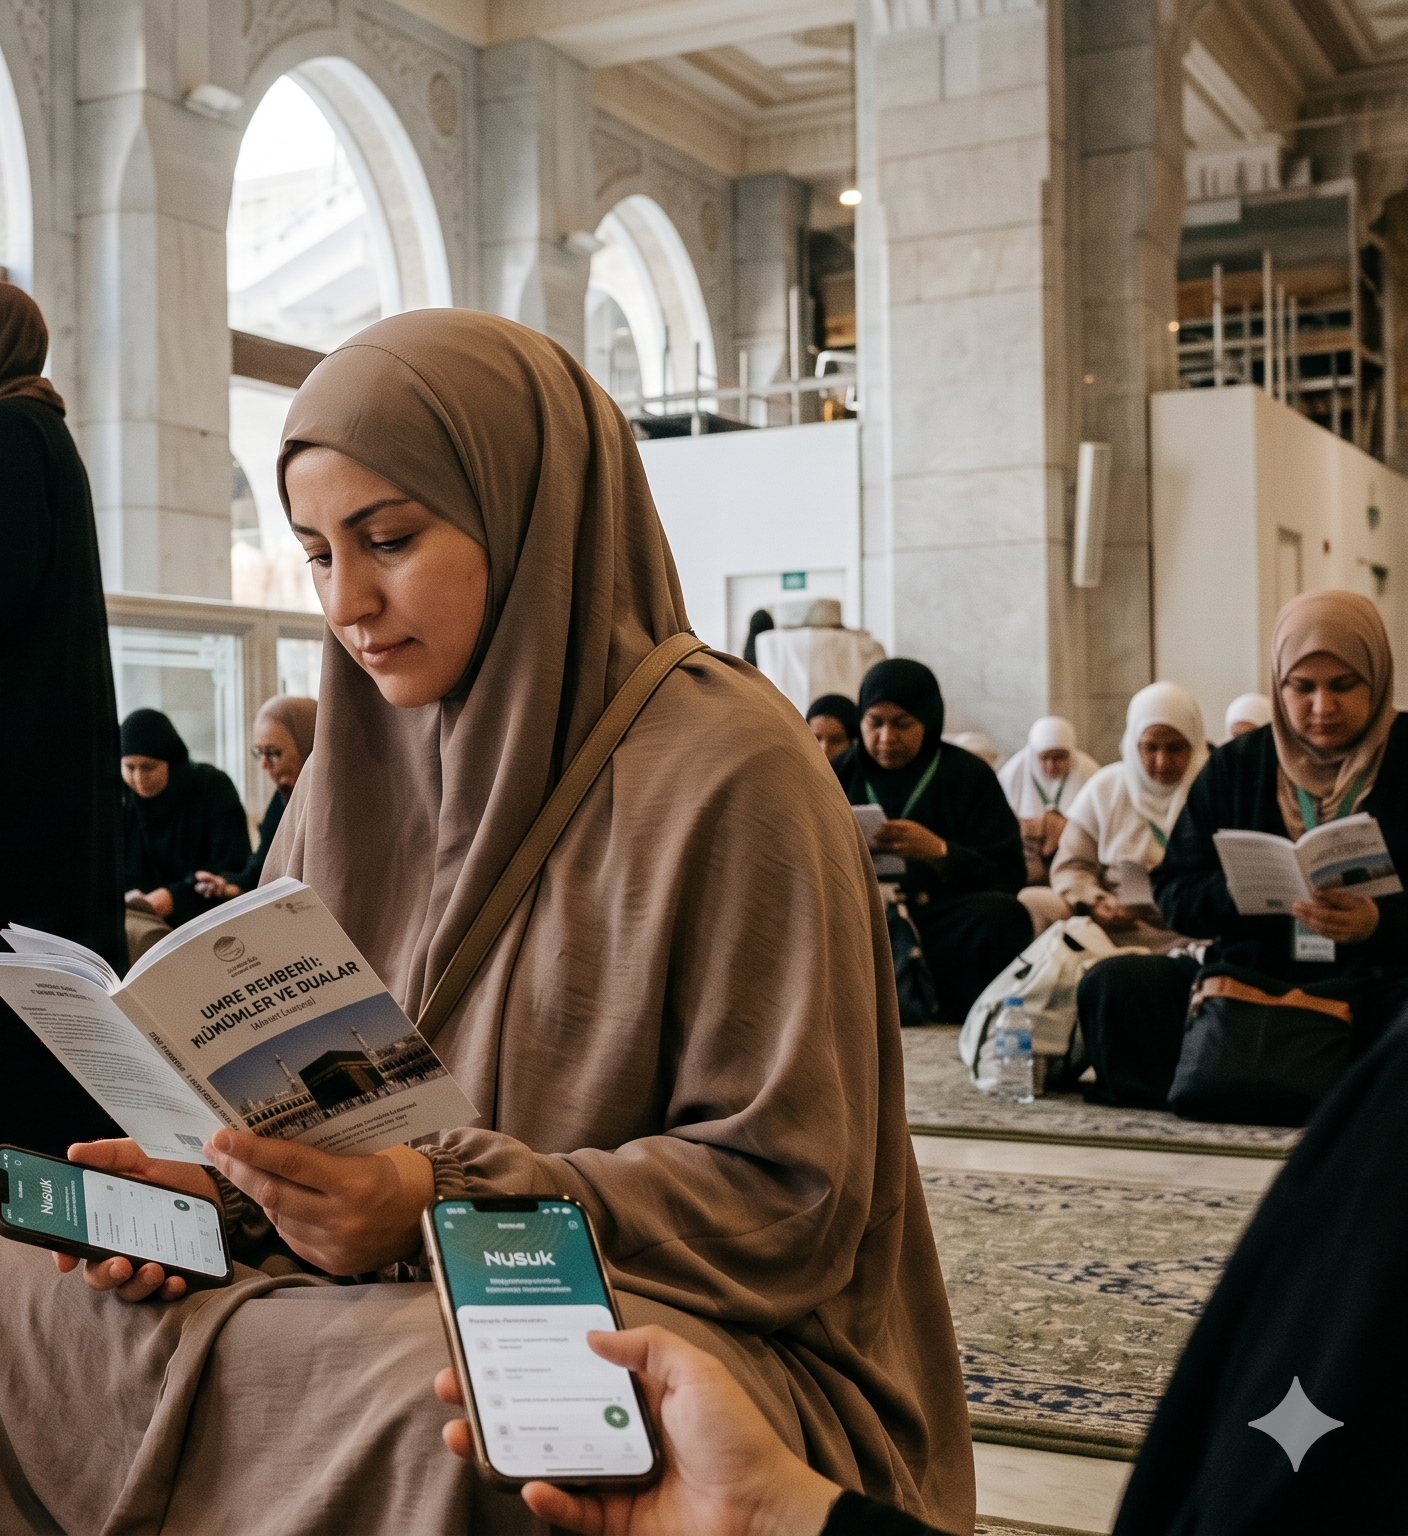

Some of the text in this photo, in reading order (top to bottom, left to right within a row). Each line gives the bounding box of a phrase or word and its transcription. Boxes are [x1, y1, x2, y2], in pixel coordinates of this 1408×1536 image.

[273, 986, 298, 1002] VE
[296, 960, 360, 994] DUALAR
[200, 989, 246, 1020] UMRE
